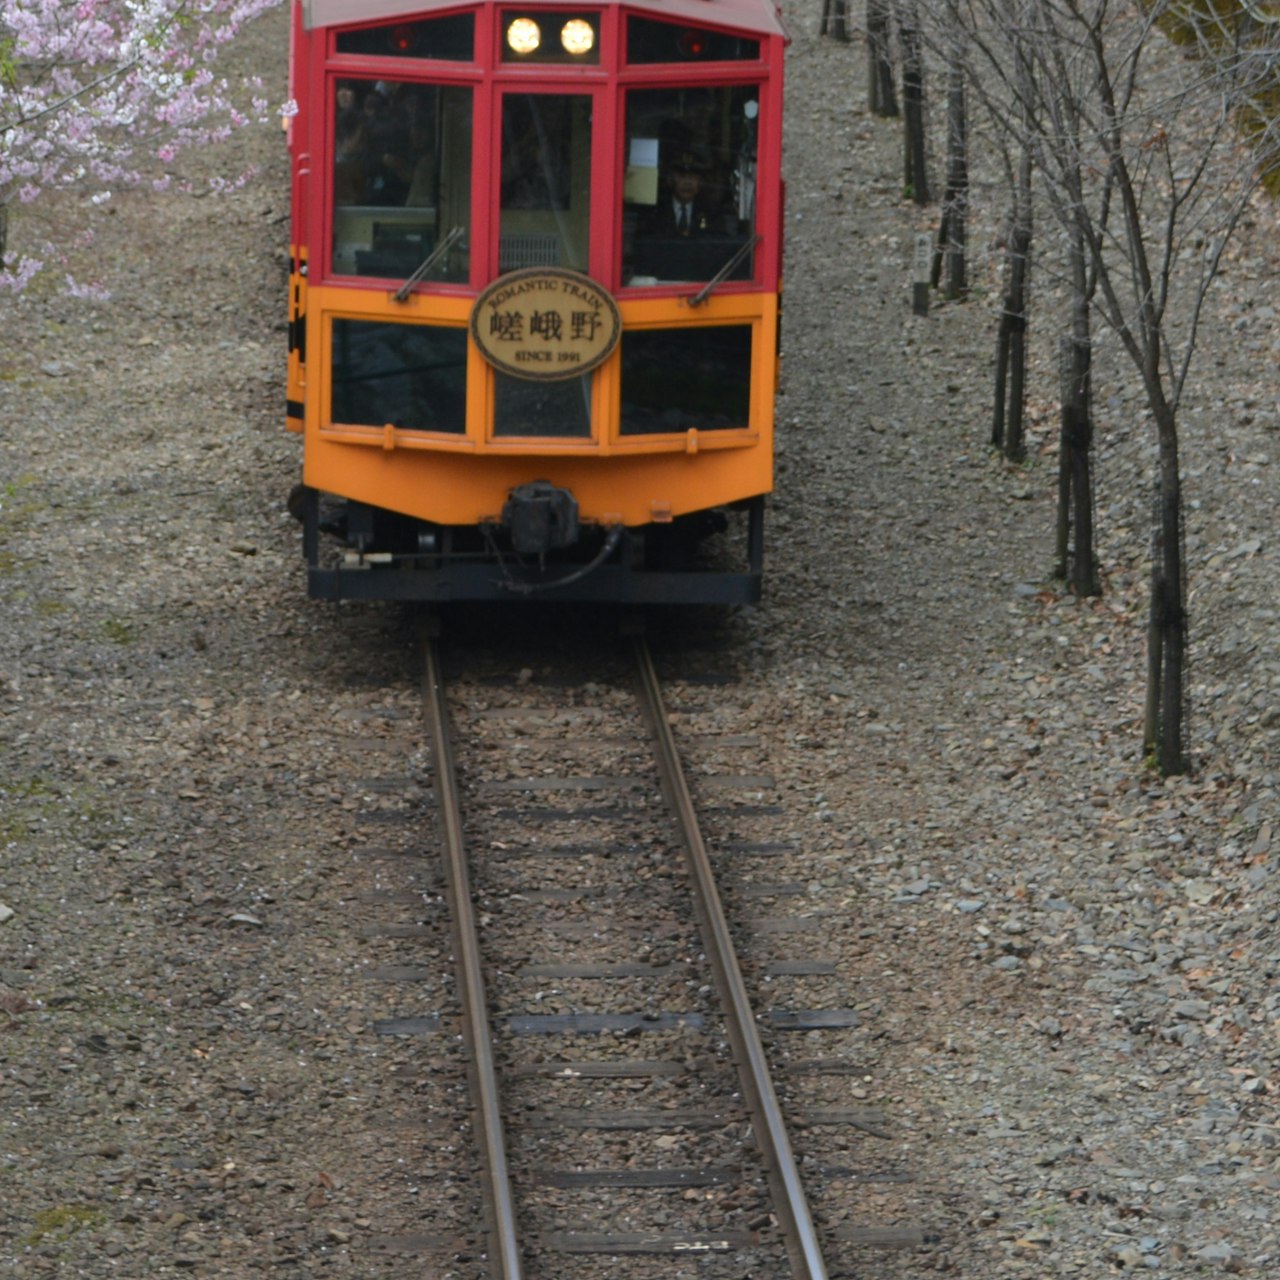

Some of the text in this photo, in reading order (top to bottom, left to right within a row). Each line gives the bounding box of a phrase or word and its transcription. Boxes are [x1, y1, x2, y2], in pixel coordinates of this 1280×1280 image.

[488, 279, 603, 310] ROMANTIC TRAIN
[489, 310, 601, 341] 嵯峨野
[515, 350, 581, 363] SINCE 1991
